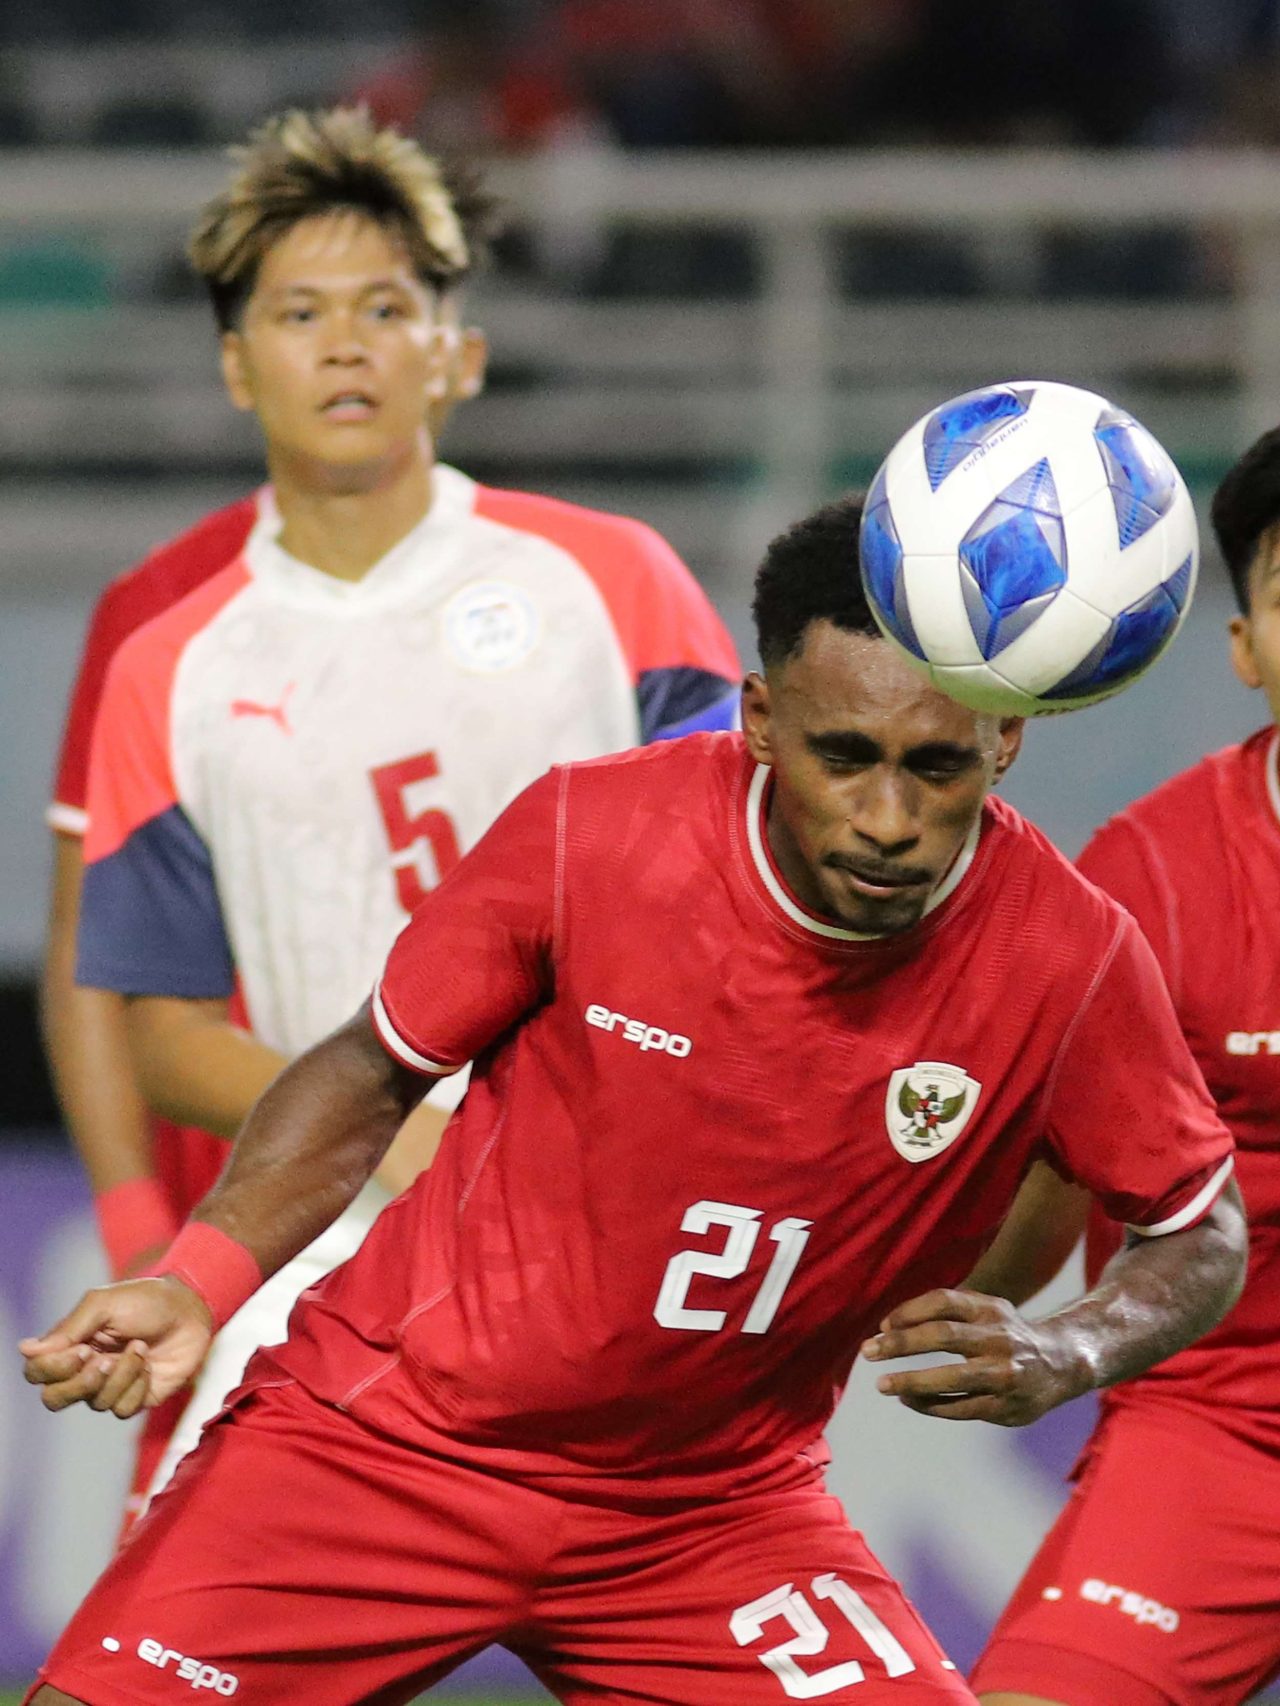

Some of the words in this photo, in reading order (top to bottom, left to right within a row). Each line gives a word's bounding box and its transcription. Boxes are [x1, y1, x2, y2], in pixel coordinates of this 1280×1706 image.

[370, 751, 461, 912] 5
[585, 1005, 691, 1057] erspo
[654, 1200, 814, 1334] 21
[729, 1572, 916, 1699] 21
[1079, 1578, 1179, 1632] erspo
[138, 1638, 238, 1695] erspo
